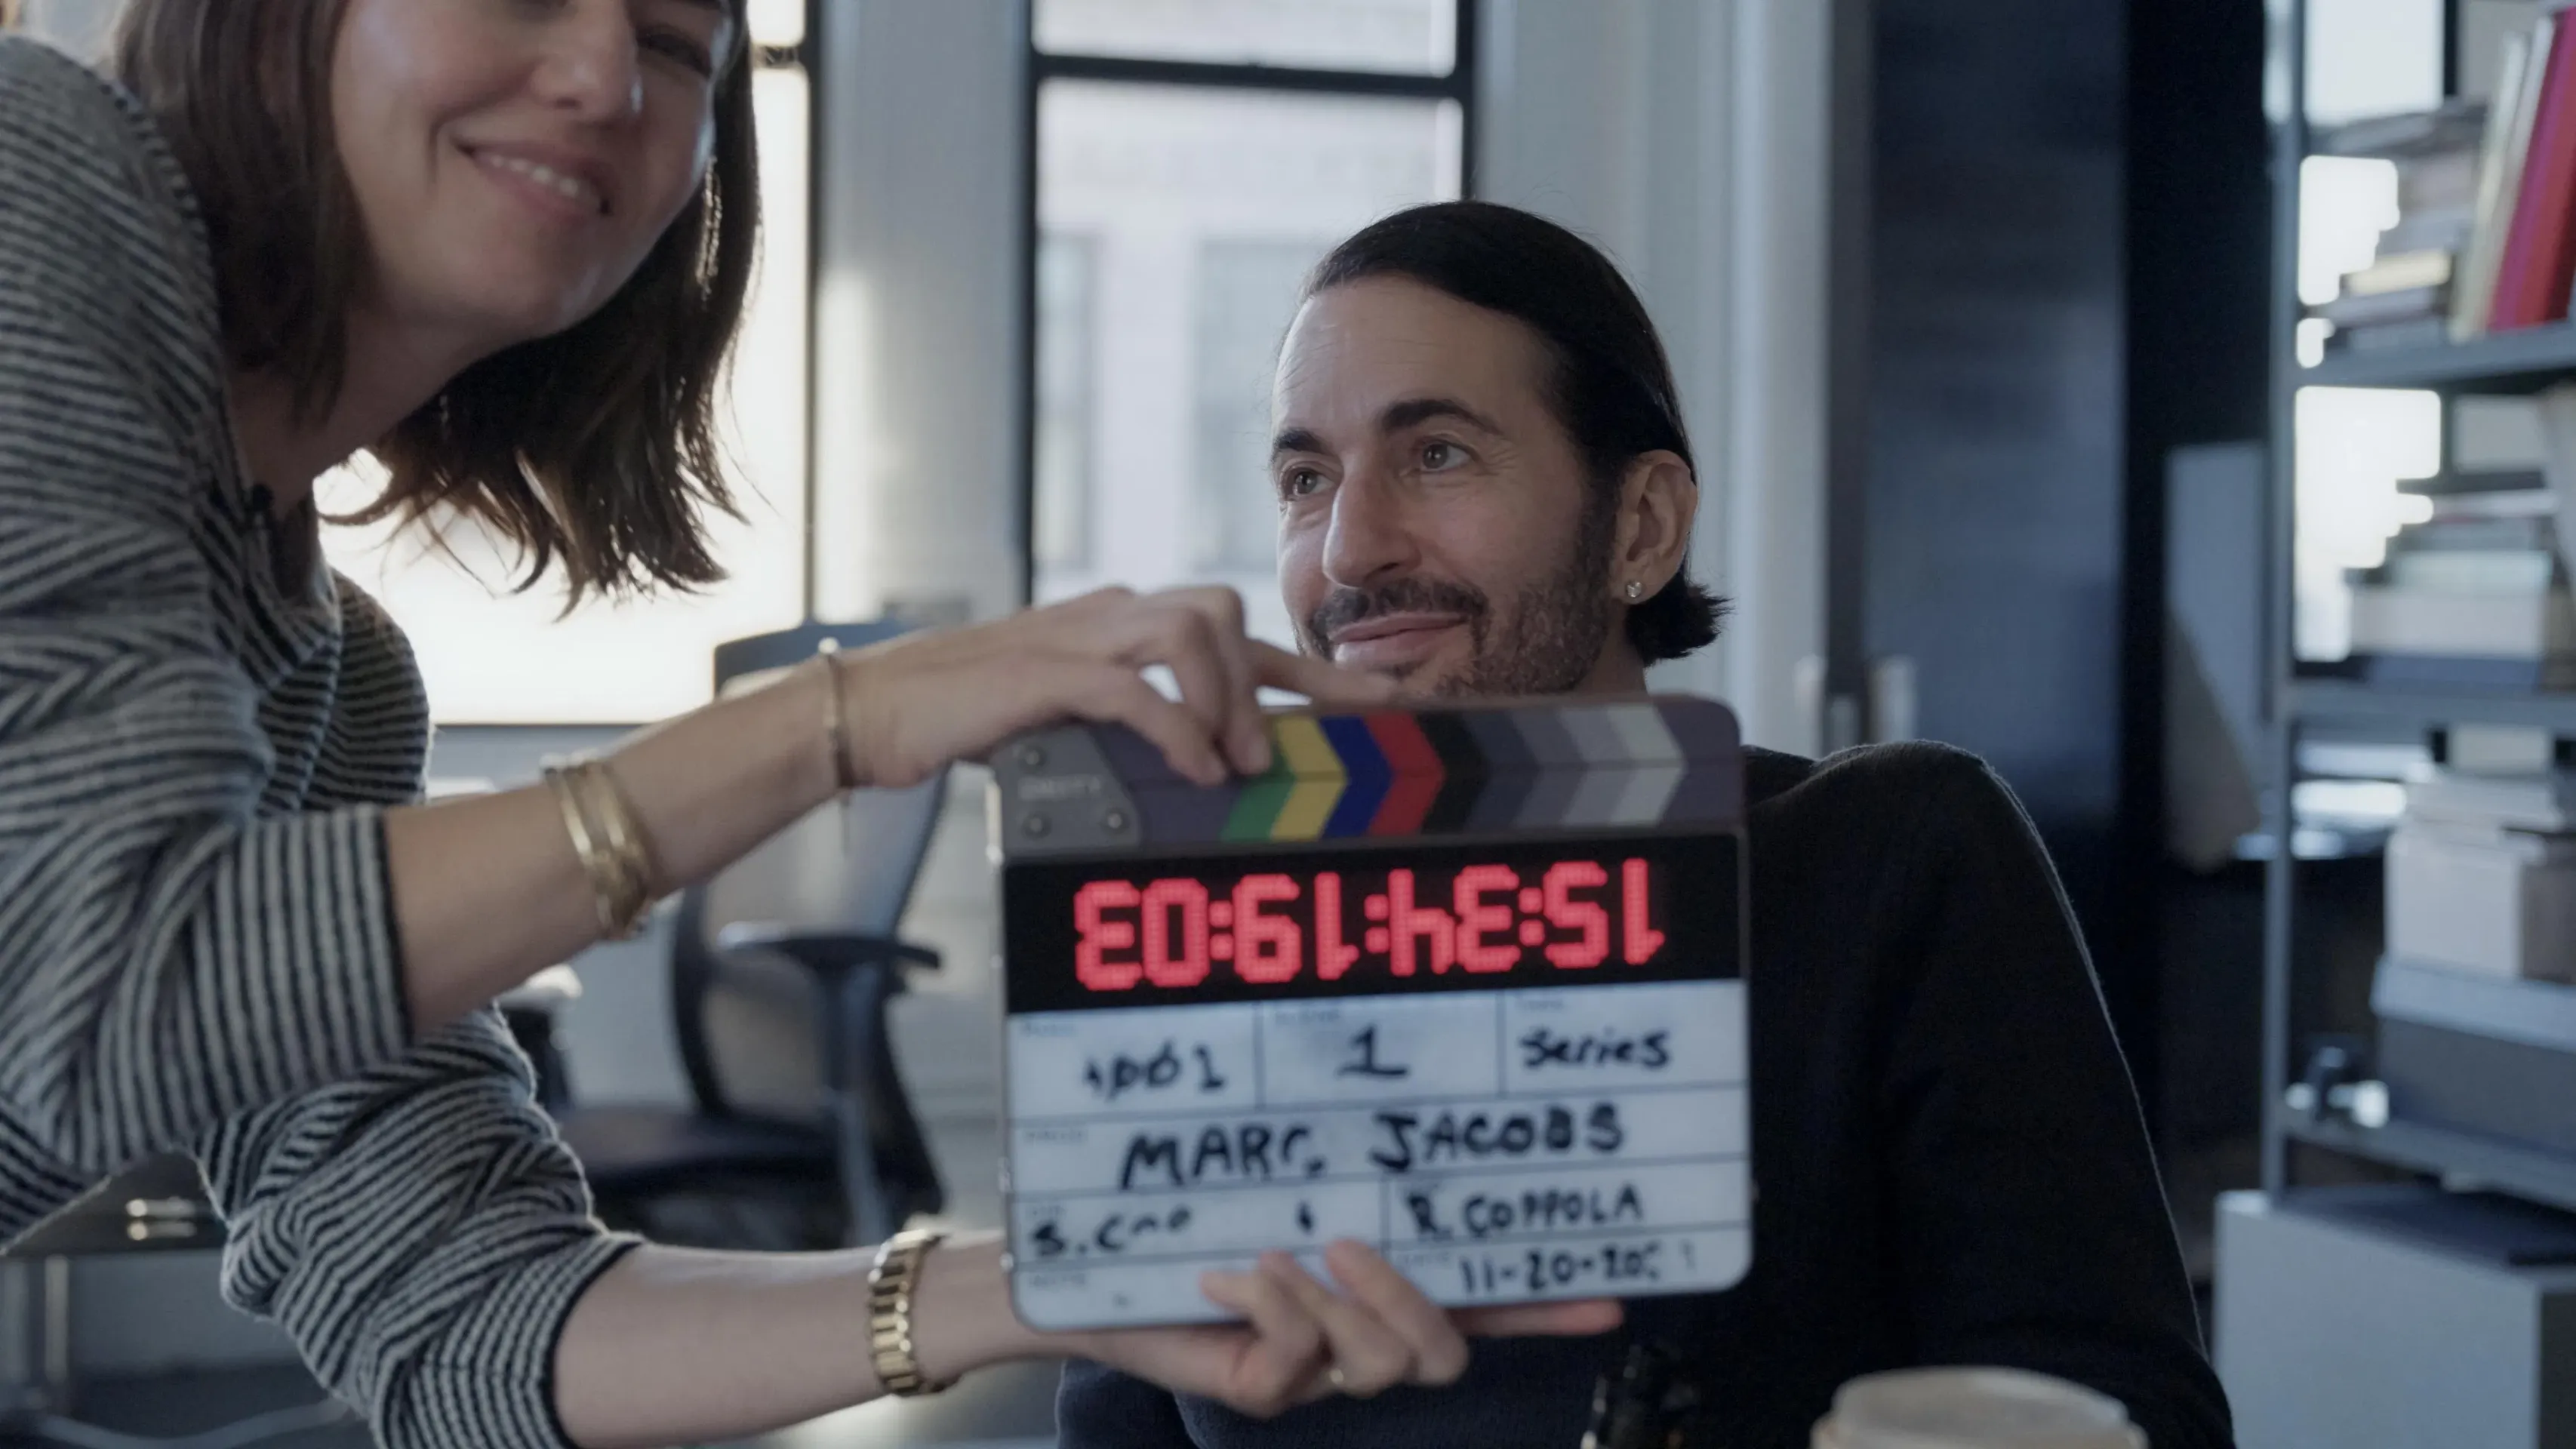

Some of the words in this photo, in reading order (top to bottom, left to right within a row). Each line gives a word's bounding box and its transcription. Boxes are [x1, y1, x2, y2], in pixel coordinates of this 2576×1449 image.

[1334, 1025, 1410, 1078] 1
[1368, 1104, 1624, 1172] JACOBS
[1463, 1182, 1644, 1239] COPPOLA
